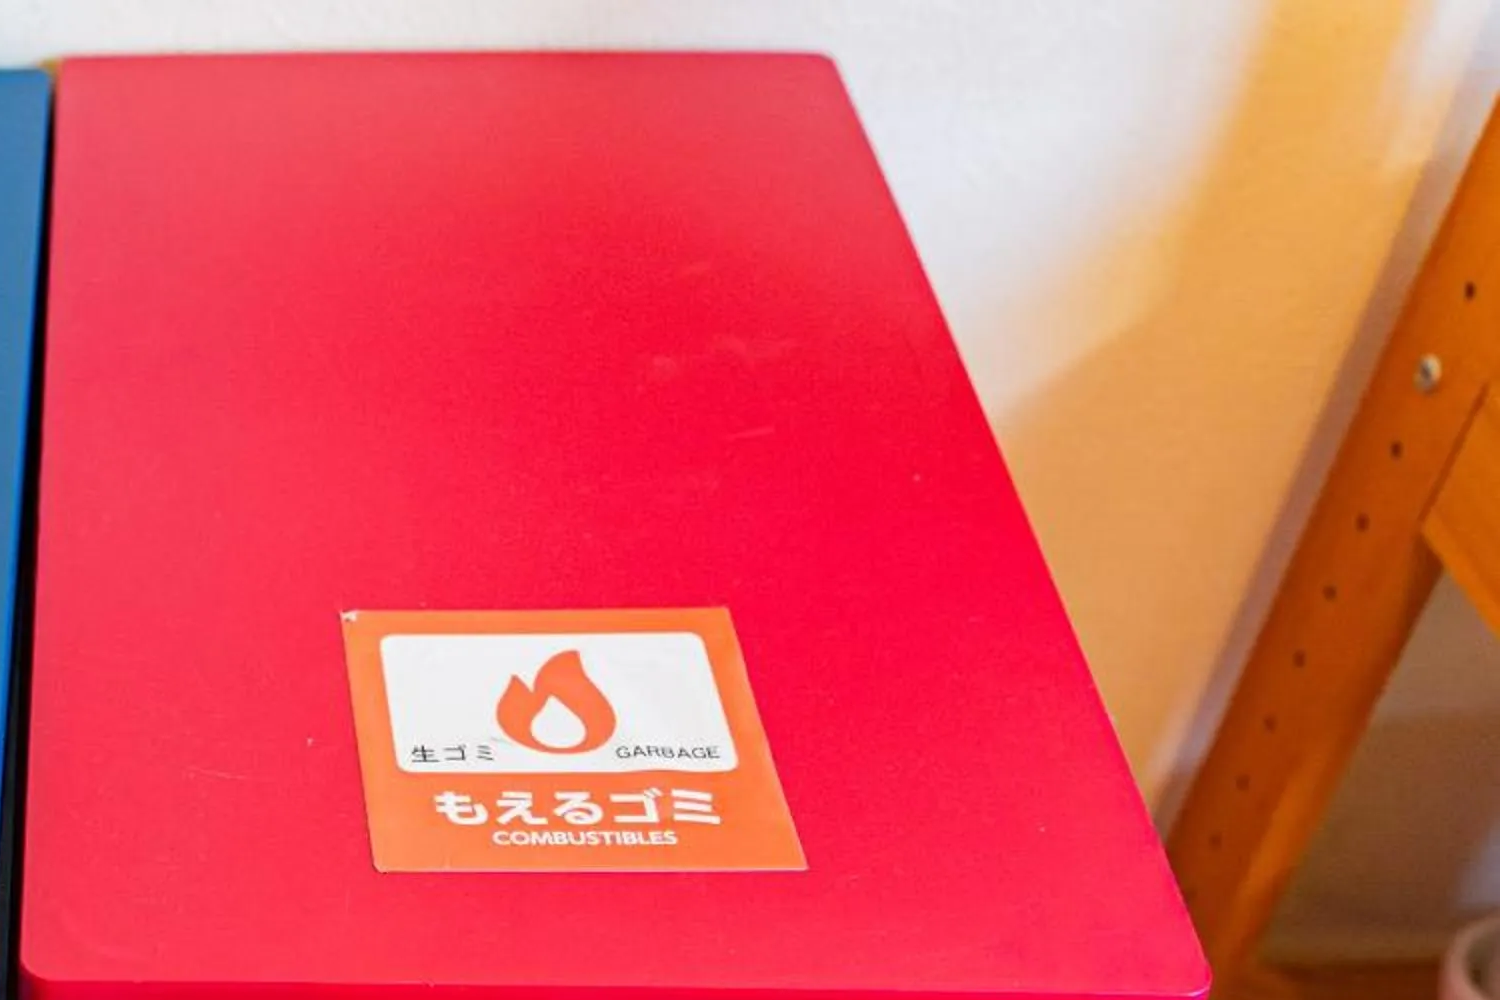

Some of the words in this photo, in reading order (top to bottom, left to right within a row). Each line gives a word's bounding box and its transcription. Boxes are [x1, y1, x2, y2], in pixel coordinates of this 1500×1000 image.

[410, 743, 495, 764] 生ゴミ
[615, 744, 721, 760] GARBAGE
[435, 787, 721, 826] もえるゴミ
[493, 830, 678, 846] COMBUSTIBLES
